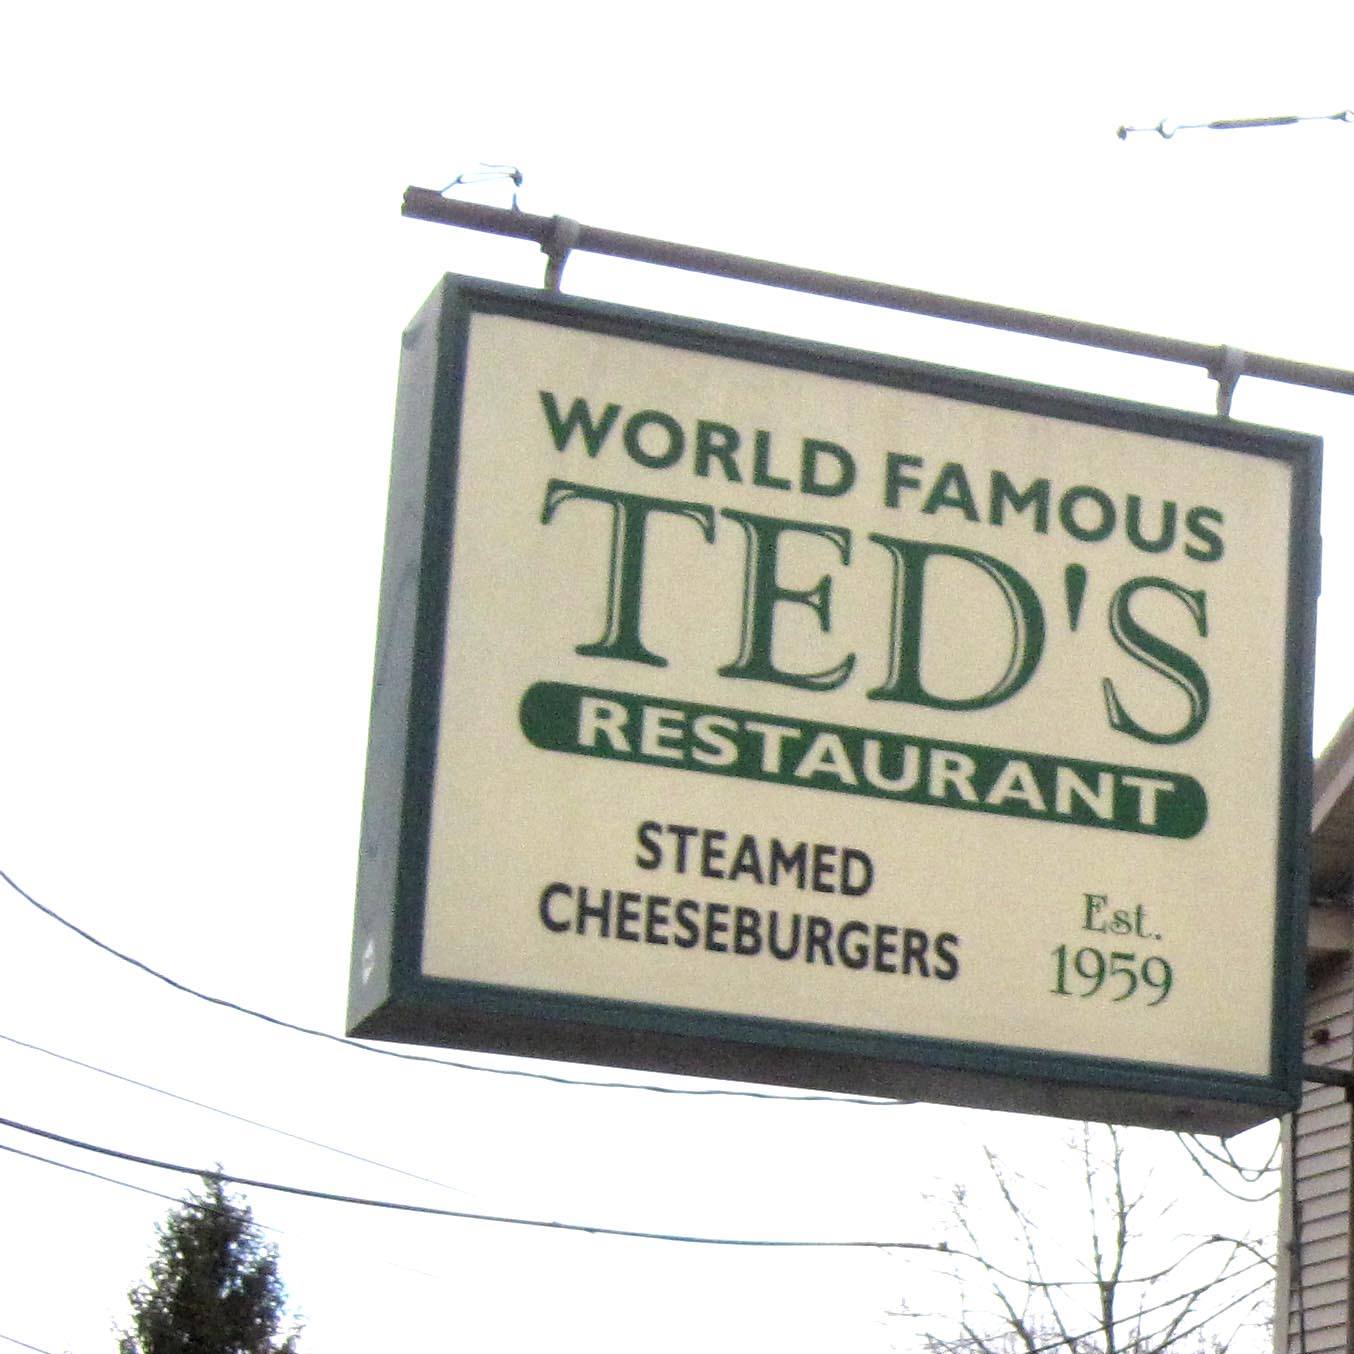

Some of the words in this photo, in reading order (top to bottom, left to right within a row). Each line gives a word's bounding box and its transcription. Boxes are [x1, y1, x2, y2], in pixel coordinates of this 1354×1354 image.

[538, 390, 856, 499] WORLD
[884, 451, 1226, 563] FAMOUS
[539, 479, 1210, 746] TED'S
[577, 696, 1175, 828] RESTAURANT
[635, 820, 872, 897] STEAMED
[538, 882, 959, 981] CHEESEBURGERS
[1081, 893, 1162, 941] Est.
[1048, 944, 1173, 1007] 1959
